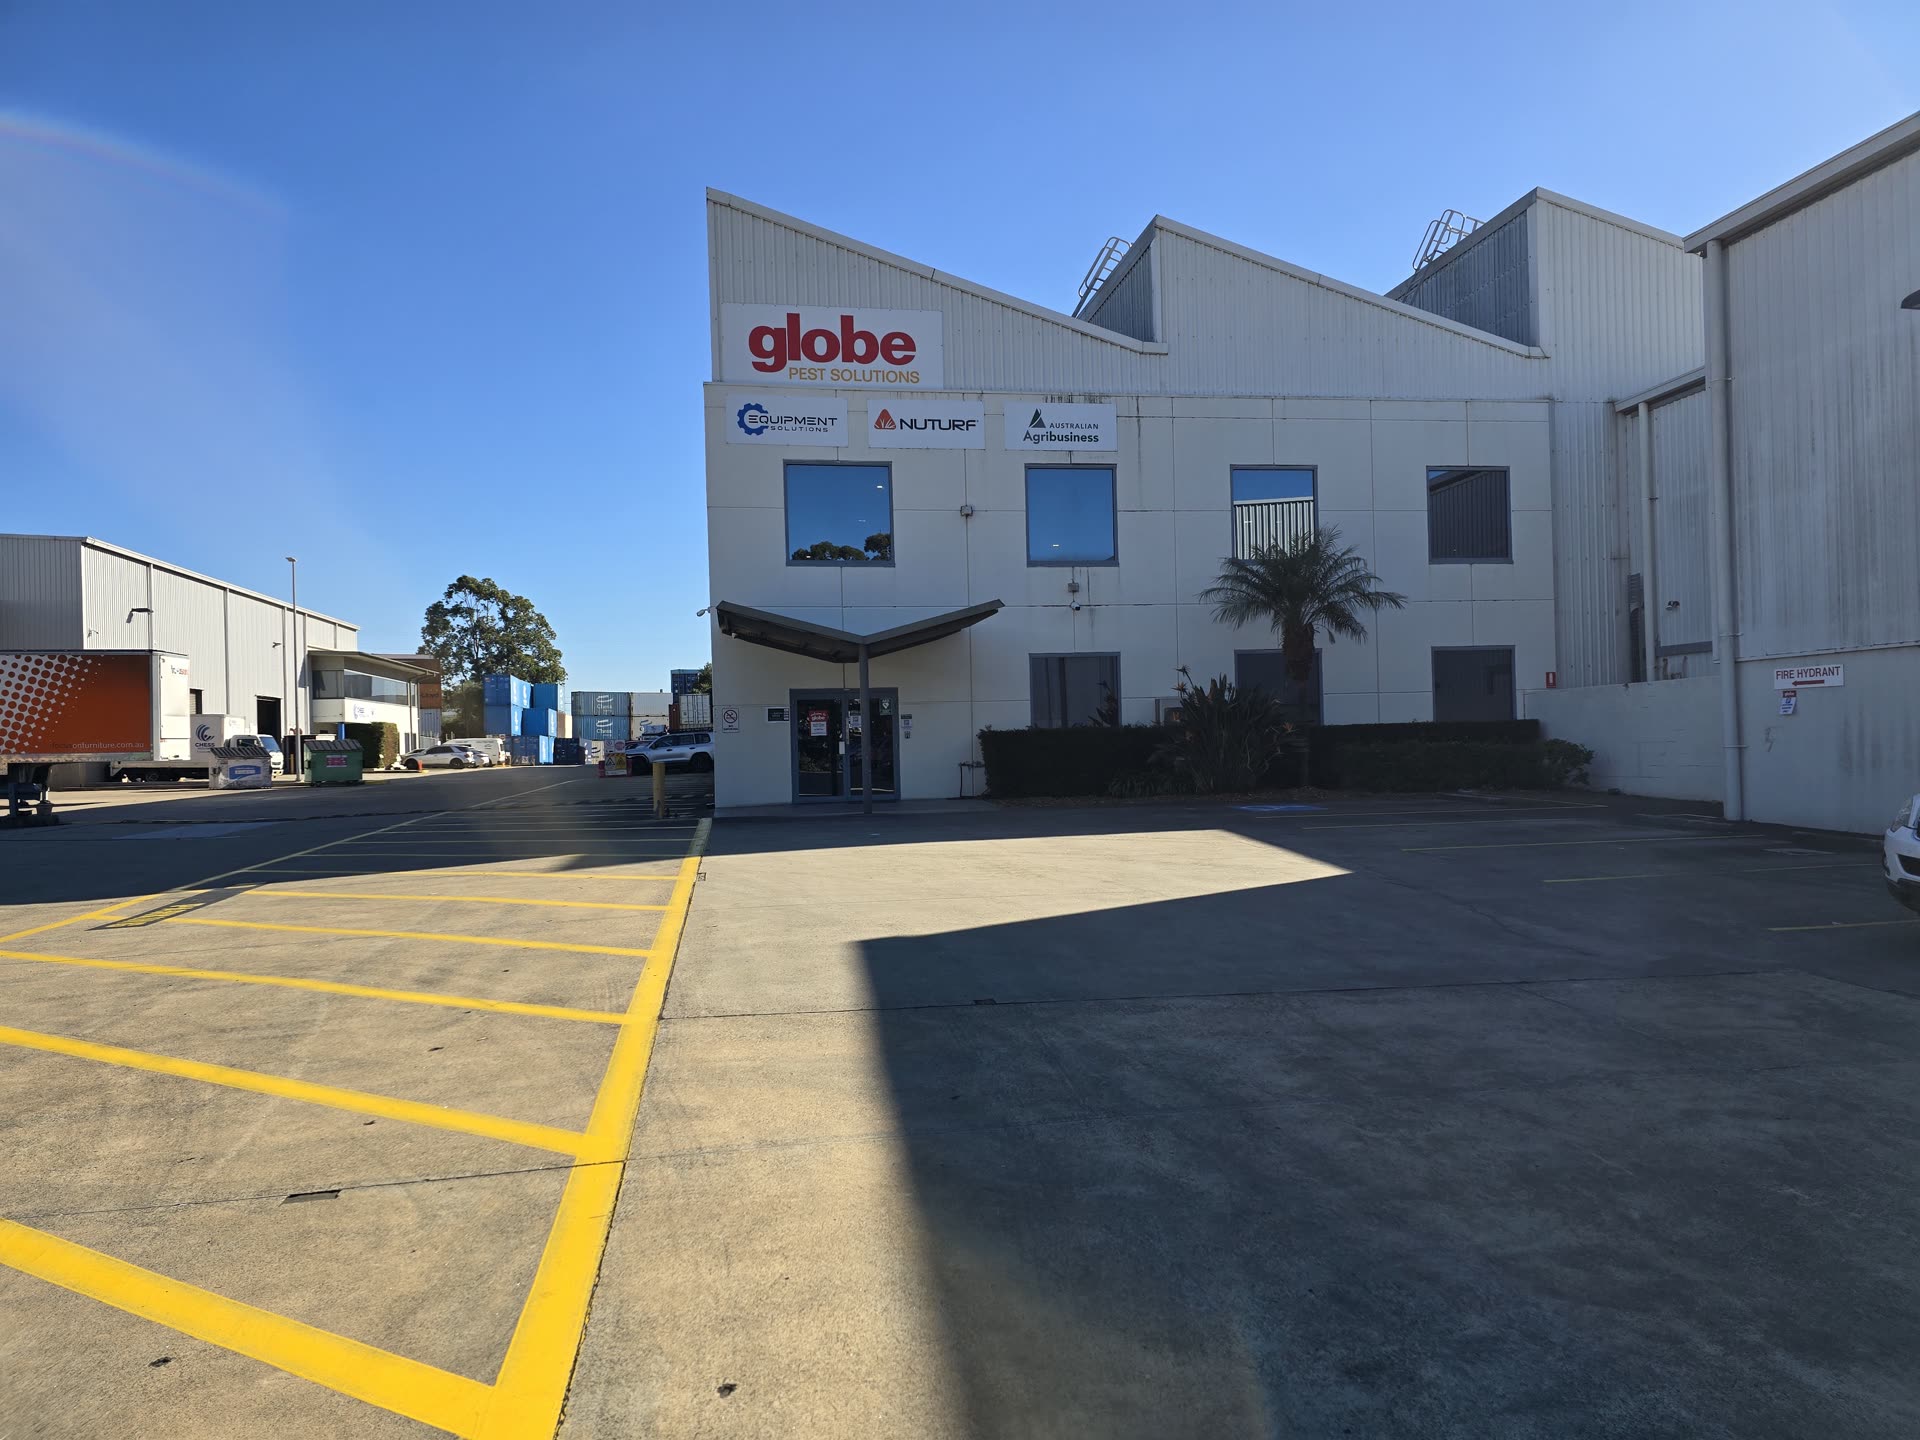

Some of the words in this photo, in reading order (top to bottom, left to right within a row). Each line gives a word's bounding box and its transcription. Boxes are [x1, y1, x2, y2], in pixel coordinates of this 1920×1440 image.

[748, 312, 917, 373] globe
[788, 367, 826, 381] PEST
[830, 368, 920, 384] SOLUTIONS
[748, 414, 838, 426] EQUIPMENT
[899, 418, 977, 431] NUTURF
[1049, 422, 1099, 430] AUSTRALIAN
[770, 425, 829, 433] SOLUTIONS
[1023, 430, 1099, 445] Agribusiness
[1775, 669, 1795, 680] FIRE
[1797, 666, 1840, 679] HYDRANT
